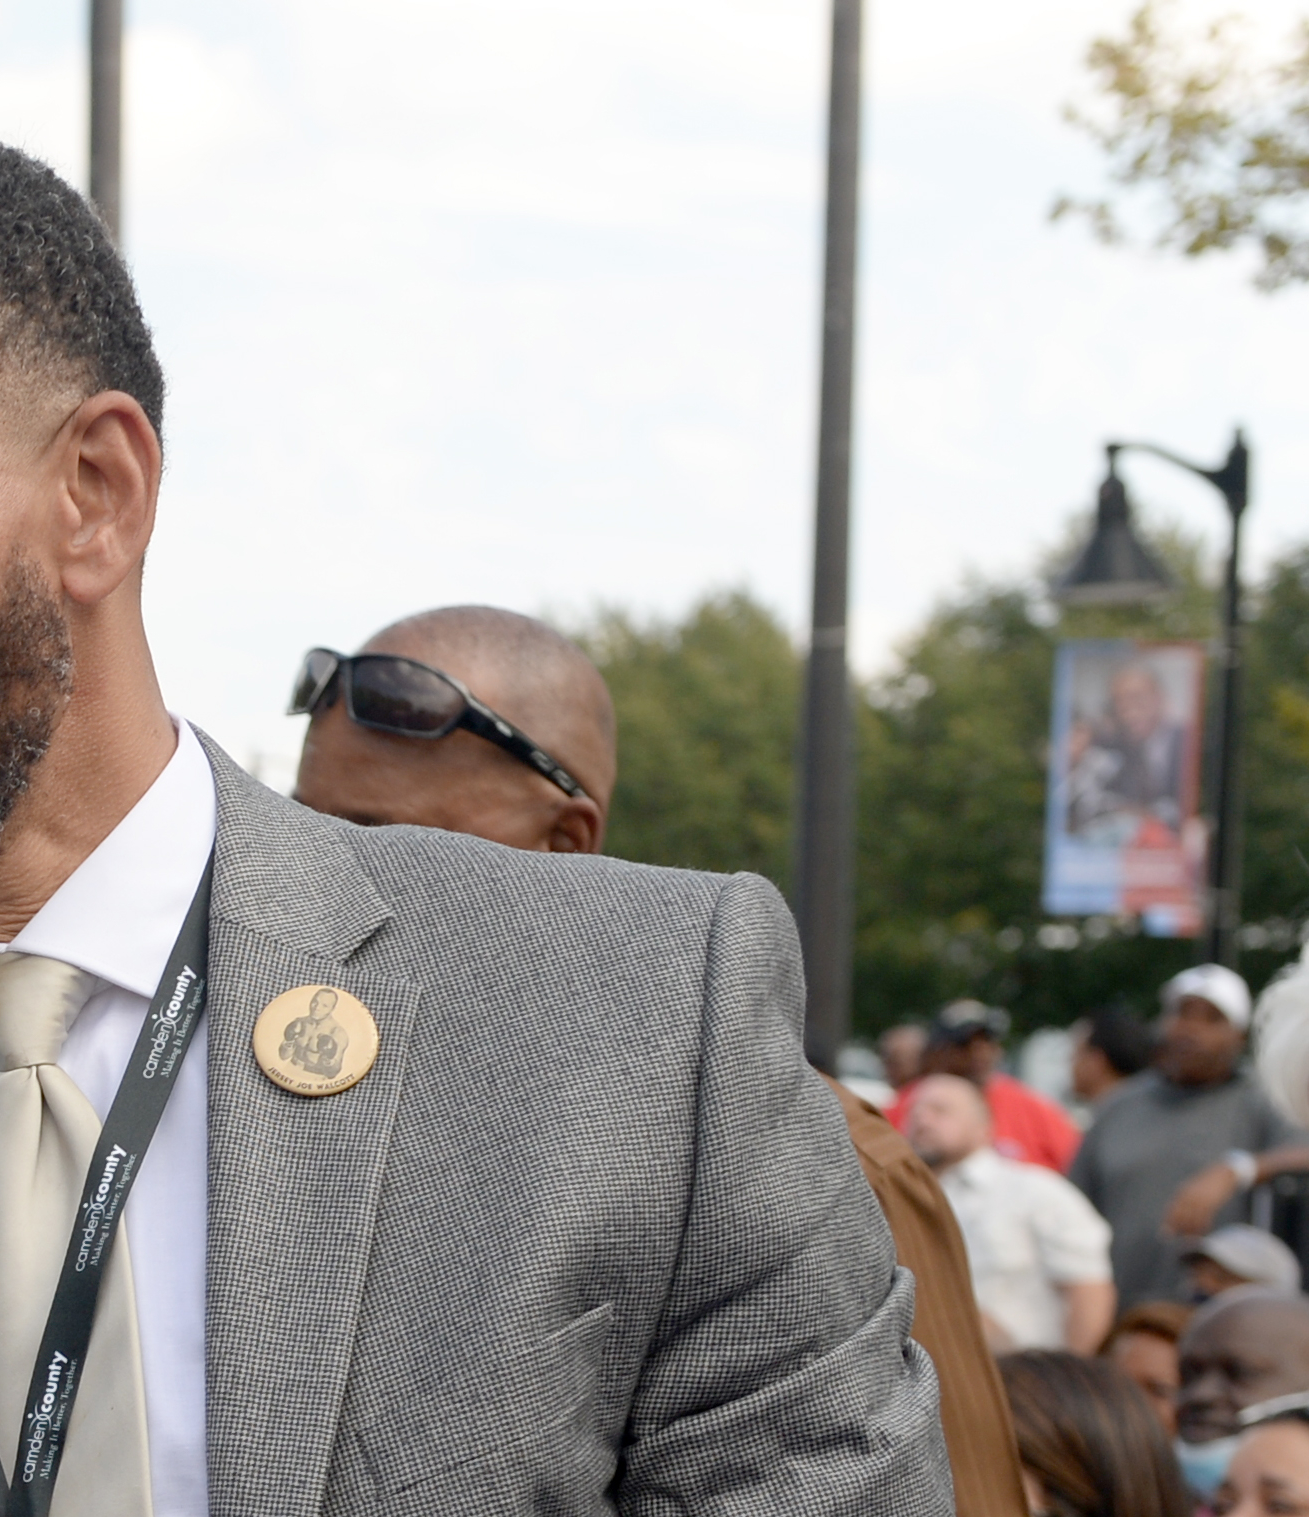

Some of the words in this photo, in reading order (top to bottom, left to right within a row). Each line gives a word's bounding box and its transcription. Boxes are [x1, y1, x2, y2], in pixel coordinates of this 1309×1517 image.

[142, 1022, 173, 1079] camden
[166, 964, 197, 1019] county
[160, 1045, 182, 1078] Making
[268, 1066, 294, 1085] JERSEY
[296, 1081, 313, 1090] JOE
[316, 1072, 355, 1090] WALCOTT
[75, 1210, 102, 1272] camden
[95, 1143, 127, 1203] county
[89, 1232, 110, 1266] Making
[23, 1420, 48, 1483] camden
[40, 1350, 68, 1413] county
[39, 1444, 59, 1480] Making
